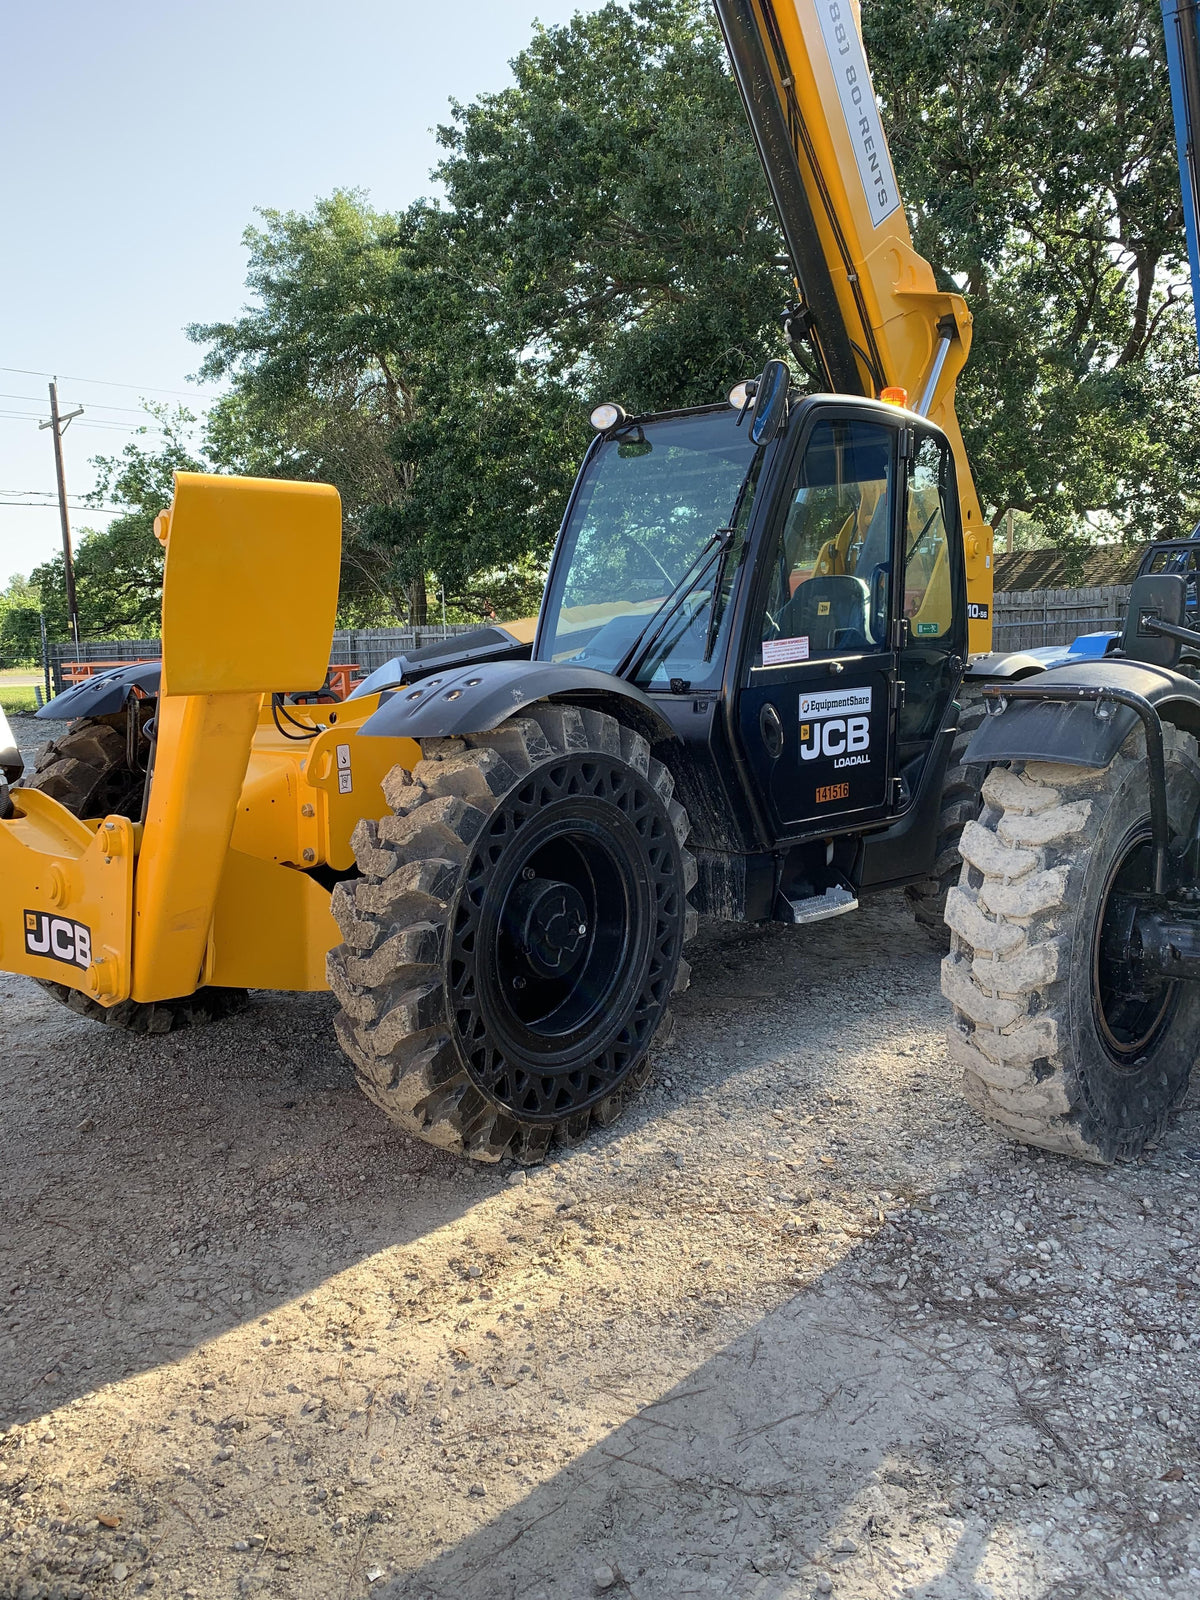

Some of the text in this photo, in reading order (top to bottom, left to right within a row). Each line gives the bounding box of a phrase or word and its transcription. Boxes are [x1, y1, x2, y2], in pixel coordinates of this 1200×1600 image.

[827, 0, 888, 207] 88) 80-RENTS
[810, 696, 870, 712] EquipmentShare
[800, 716, 870, 760] JCB
[834, 754, 871, 769] LOADALL
[816, 783, 849, 801] 141516
[26, 916, 92, 968] JCB
